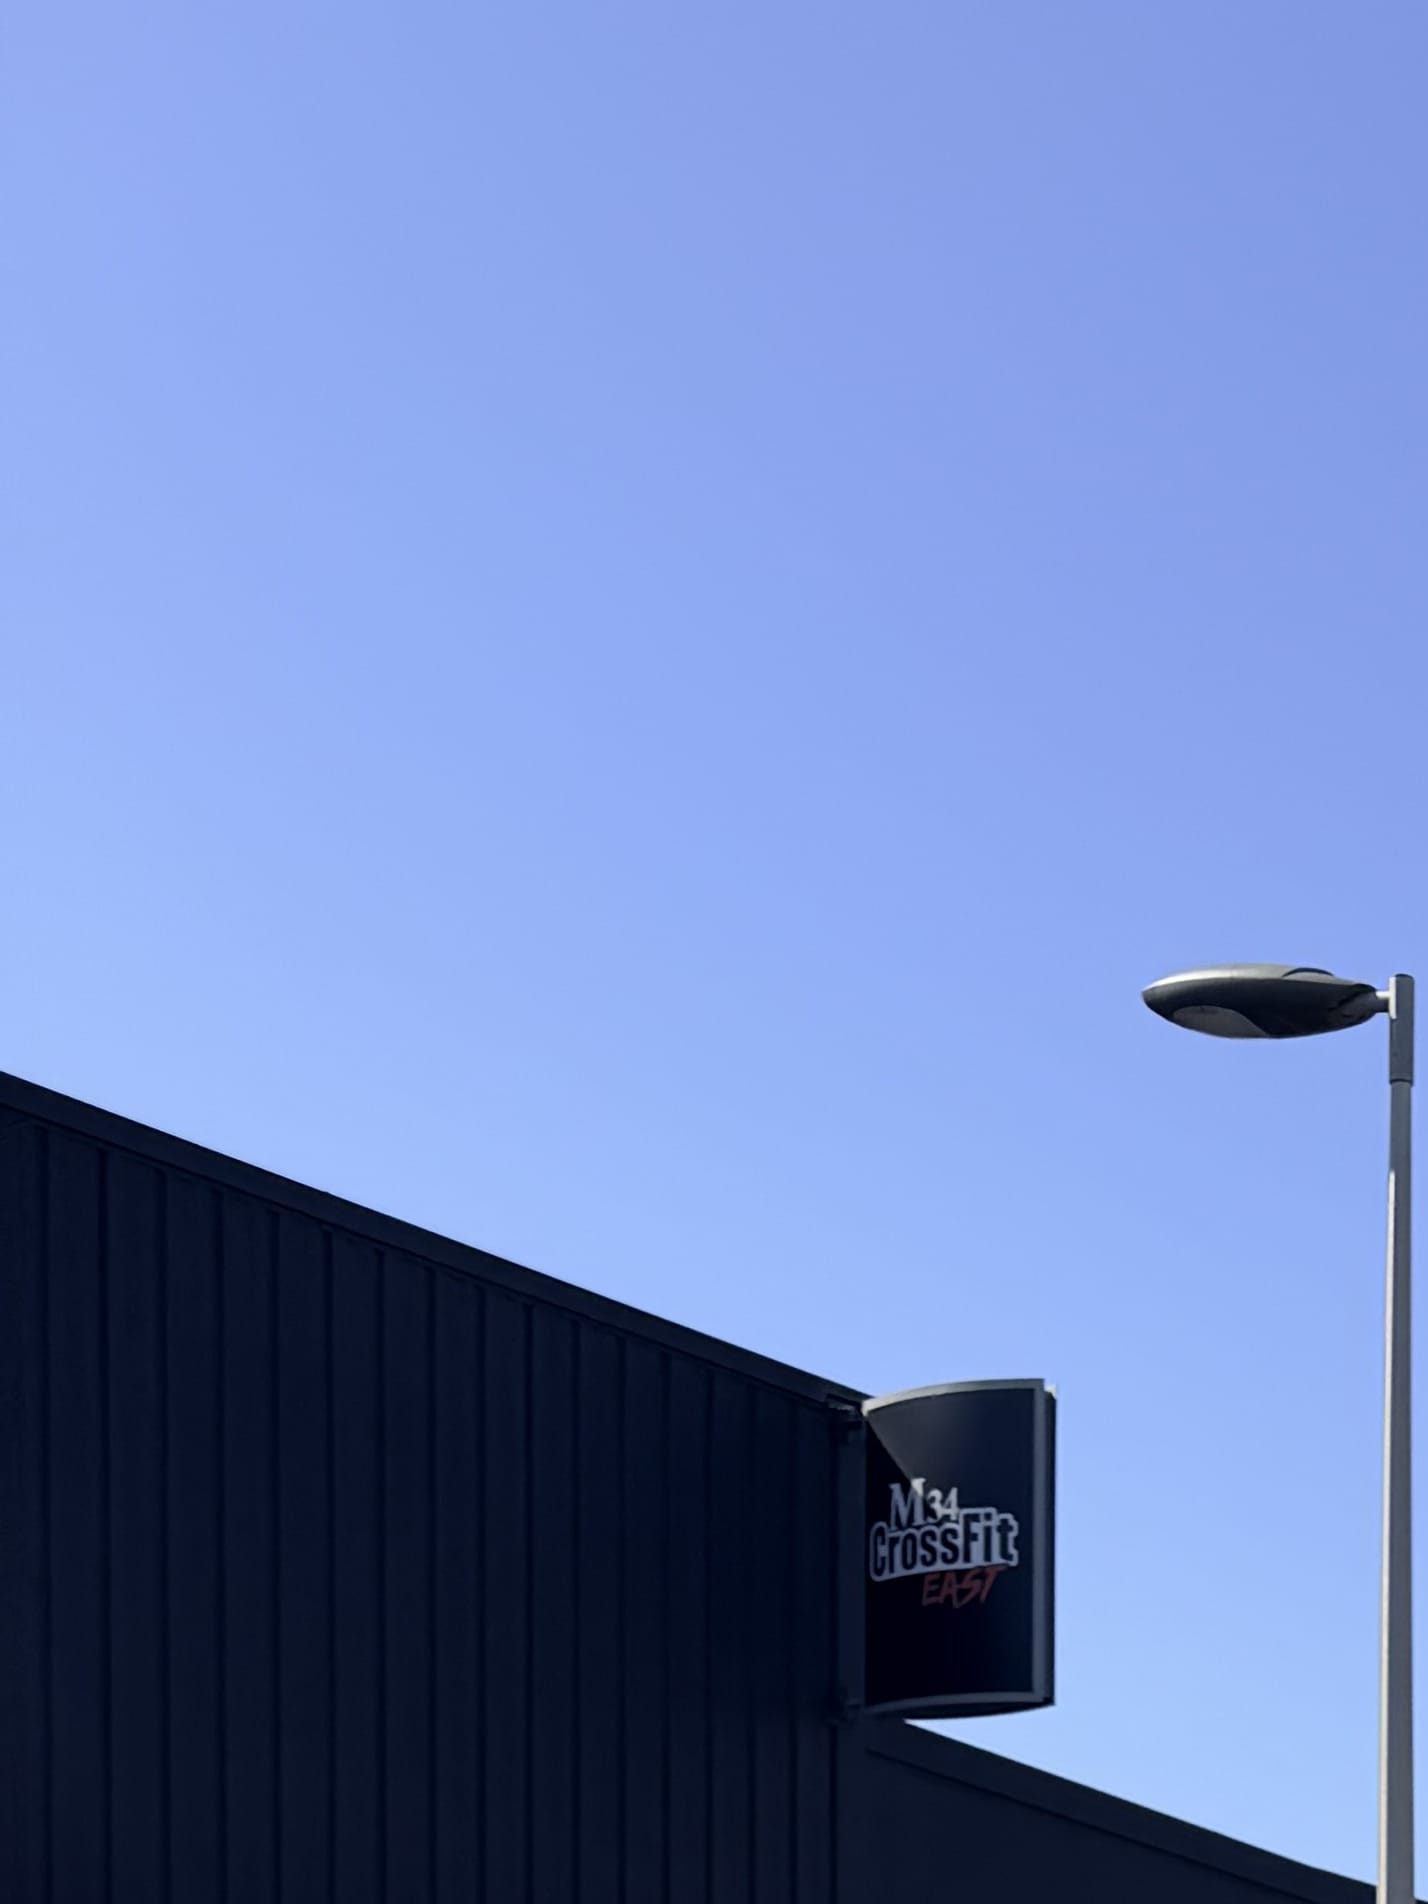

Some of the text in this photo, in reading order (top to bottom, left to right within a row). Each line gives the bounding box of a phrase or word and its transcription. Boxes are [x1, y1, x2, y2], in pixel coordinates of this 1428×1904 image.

[889, 1477, 959, 1532] M34
[870, 1508, 1018, 1581] CrossFit
[922, 1565, 1007, 1608] EAST
